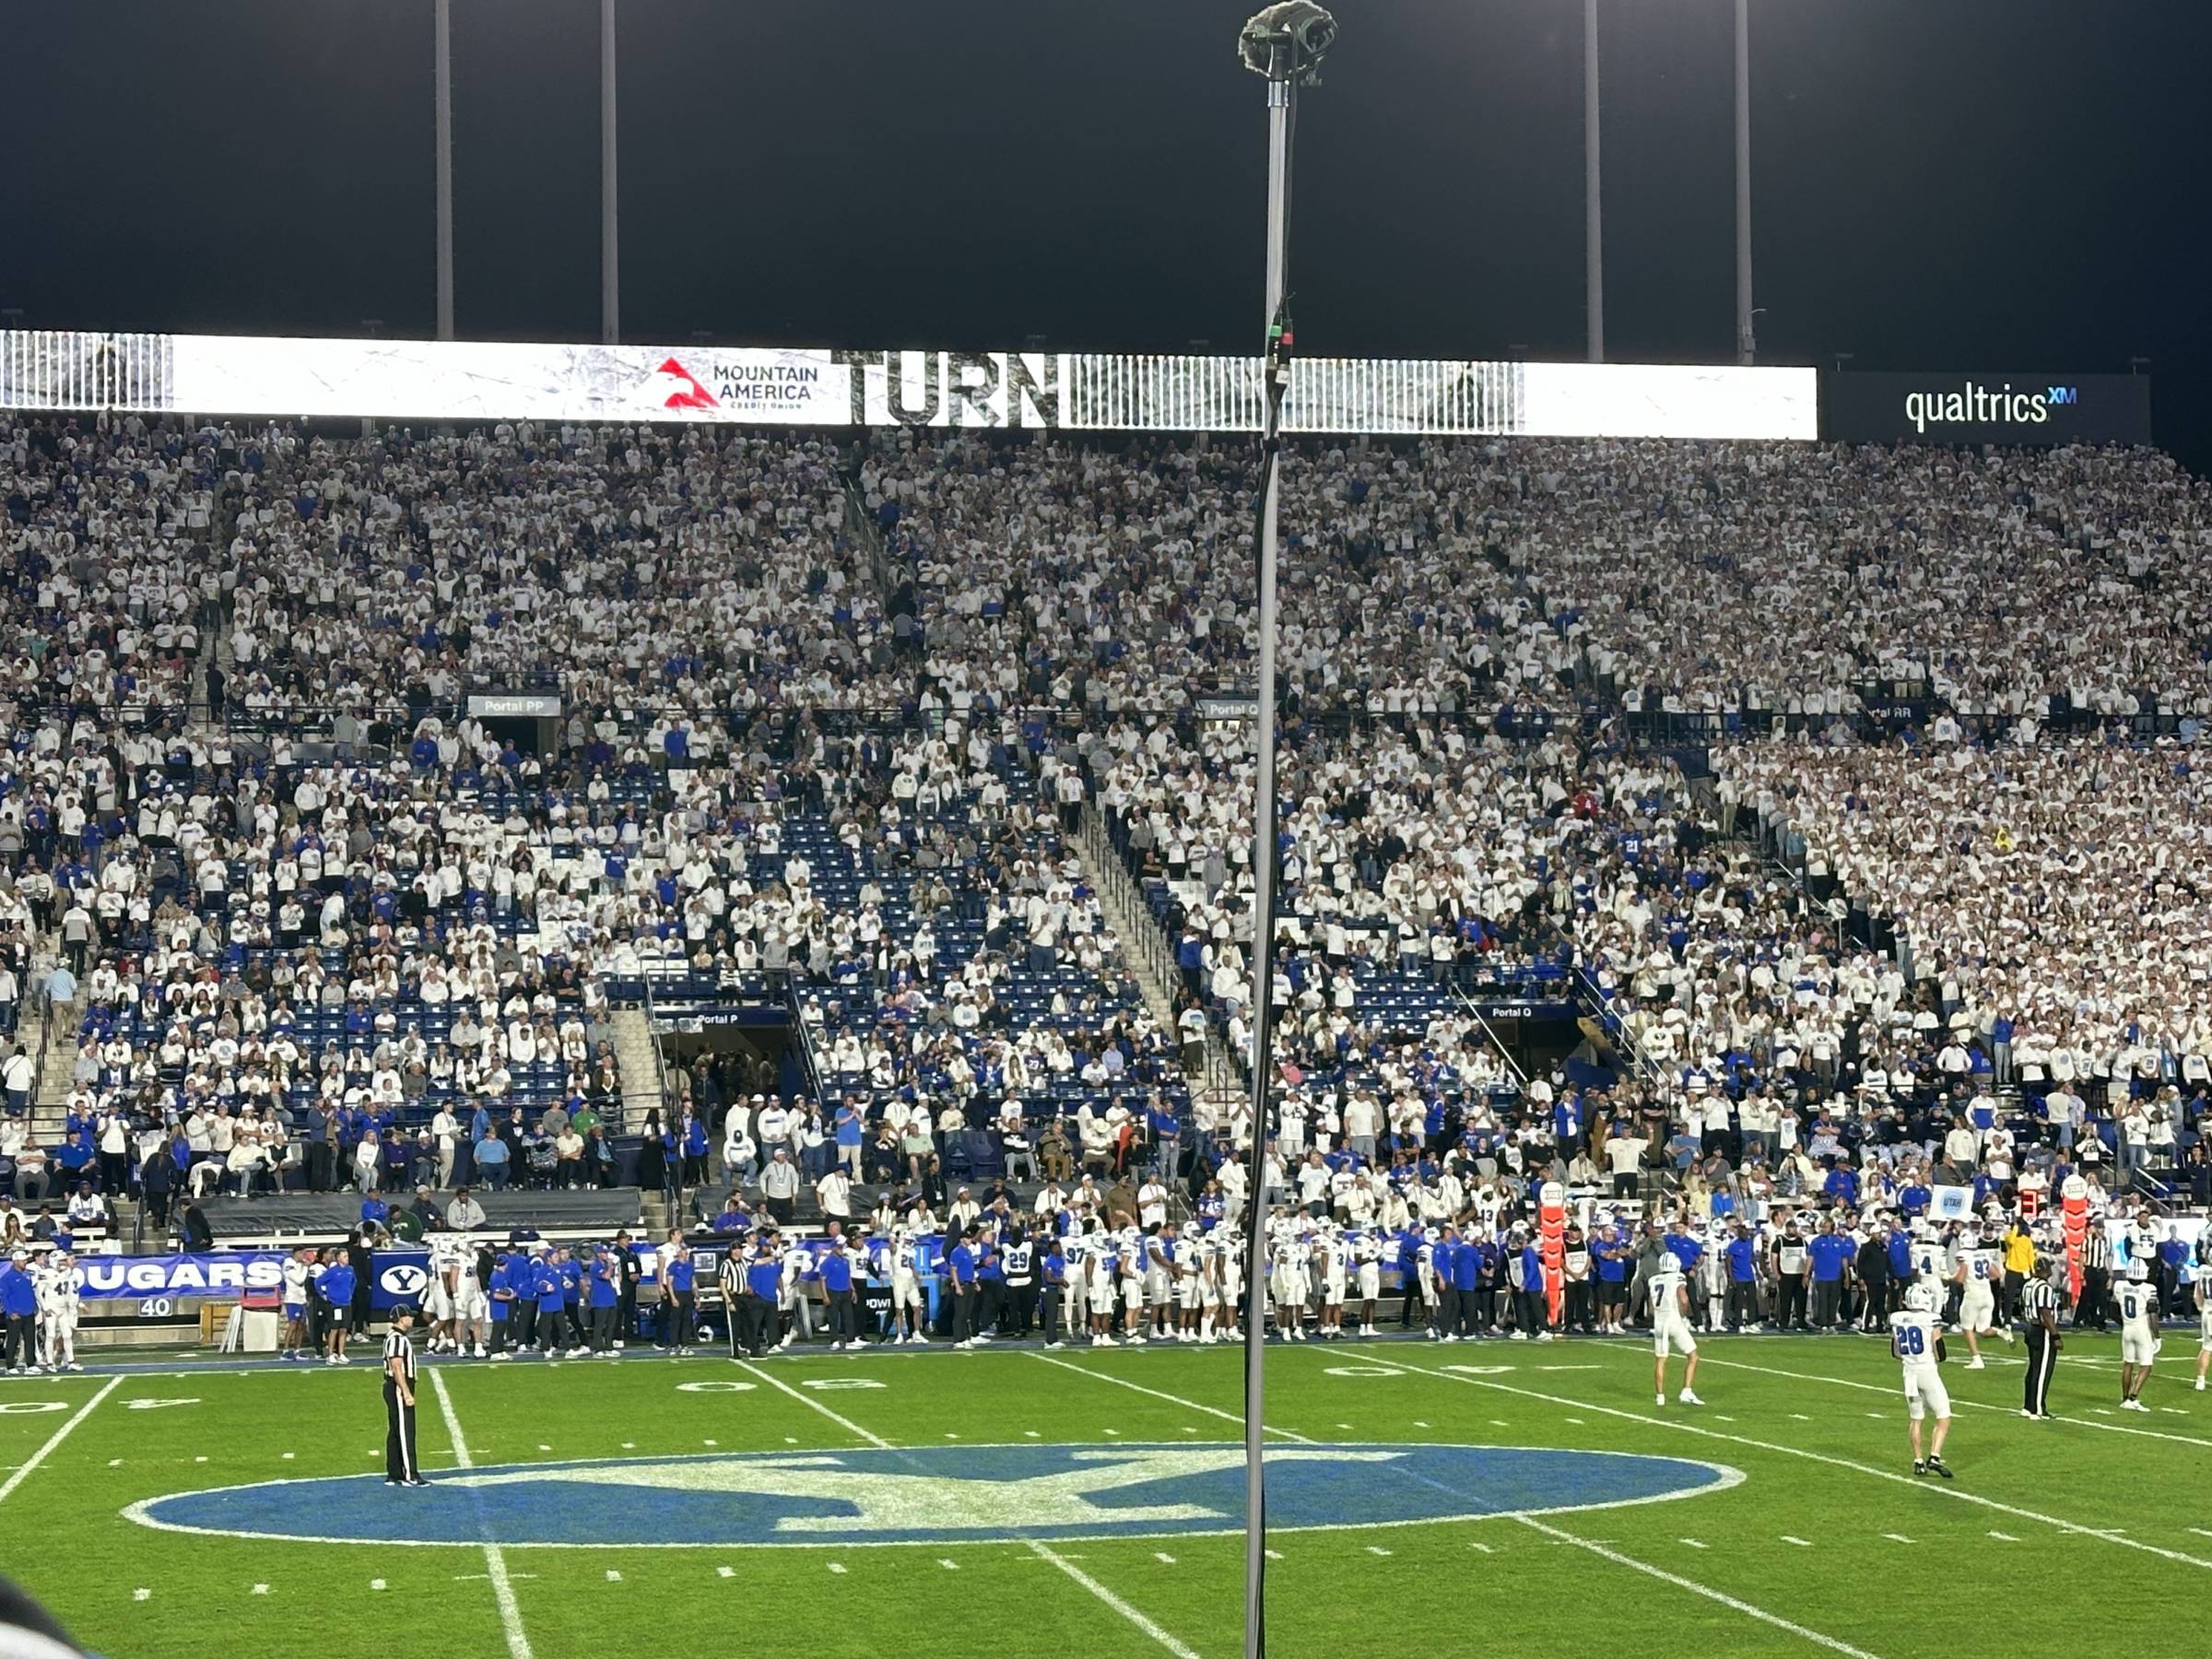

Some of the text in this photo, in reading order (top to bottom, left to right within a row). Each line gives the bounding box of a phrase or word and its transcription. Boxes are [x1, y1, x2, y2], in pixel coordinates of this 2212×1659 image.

[713, 365, 818, 382] MOUNTAIN
[720, 383, 811, 400] AMERICA
[830, 349, 1058, 428] TURN
[730, 402, 766, 410] CREDIT
[1905, 381, 2077, 433] qualtrics XM
[485, 700, 544, 712] Portal PP
[1209, 704, 1245, 715] Portal
[1894, 708, 1912, 718] RR
[1625, 840, 1640, 853] 21
[698, 1015, 737, 1024] Portal P
[1493, 1008, 1532, 1018] Portal Q
[1943, 1198, 1961, 1207] UTAH
[2139, 1235, 2155, 1248] 55
[1009, 1253, 1028, 1269] 29
[1066, 1247, 1085, 1265] 97
[1921, 1255, 1932, 1274] 4
[389, 1270, 420, 1290] Y
[1654, 1284, 1665, 1307] 7
[141, 1299, 170, 1315] 40
[2124, 1295, 2136, 1319] 0
[1896, 1325, 1924, 1355] 28
